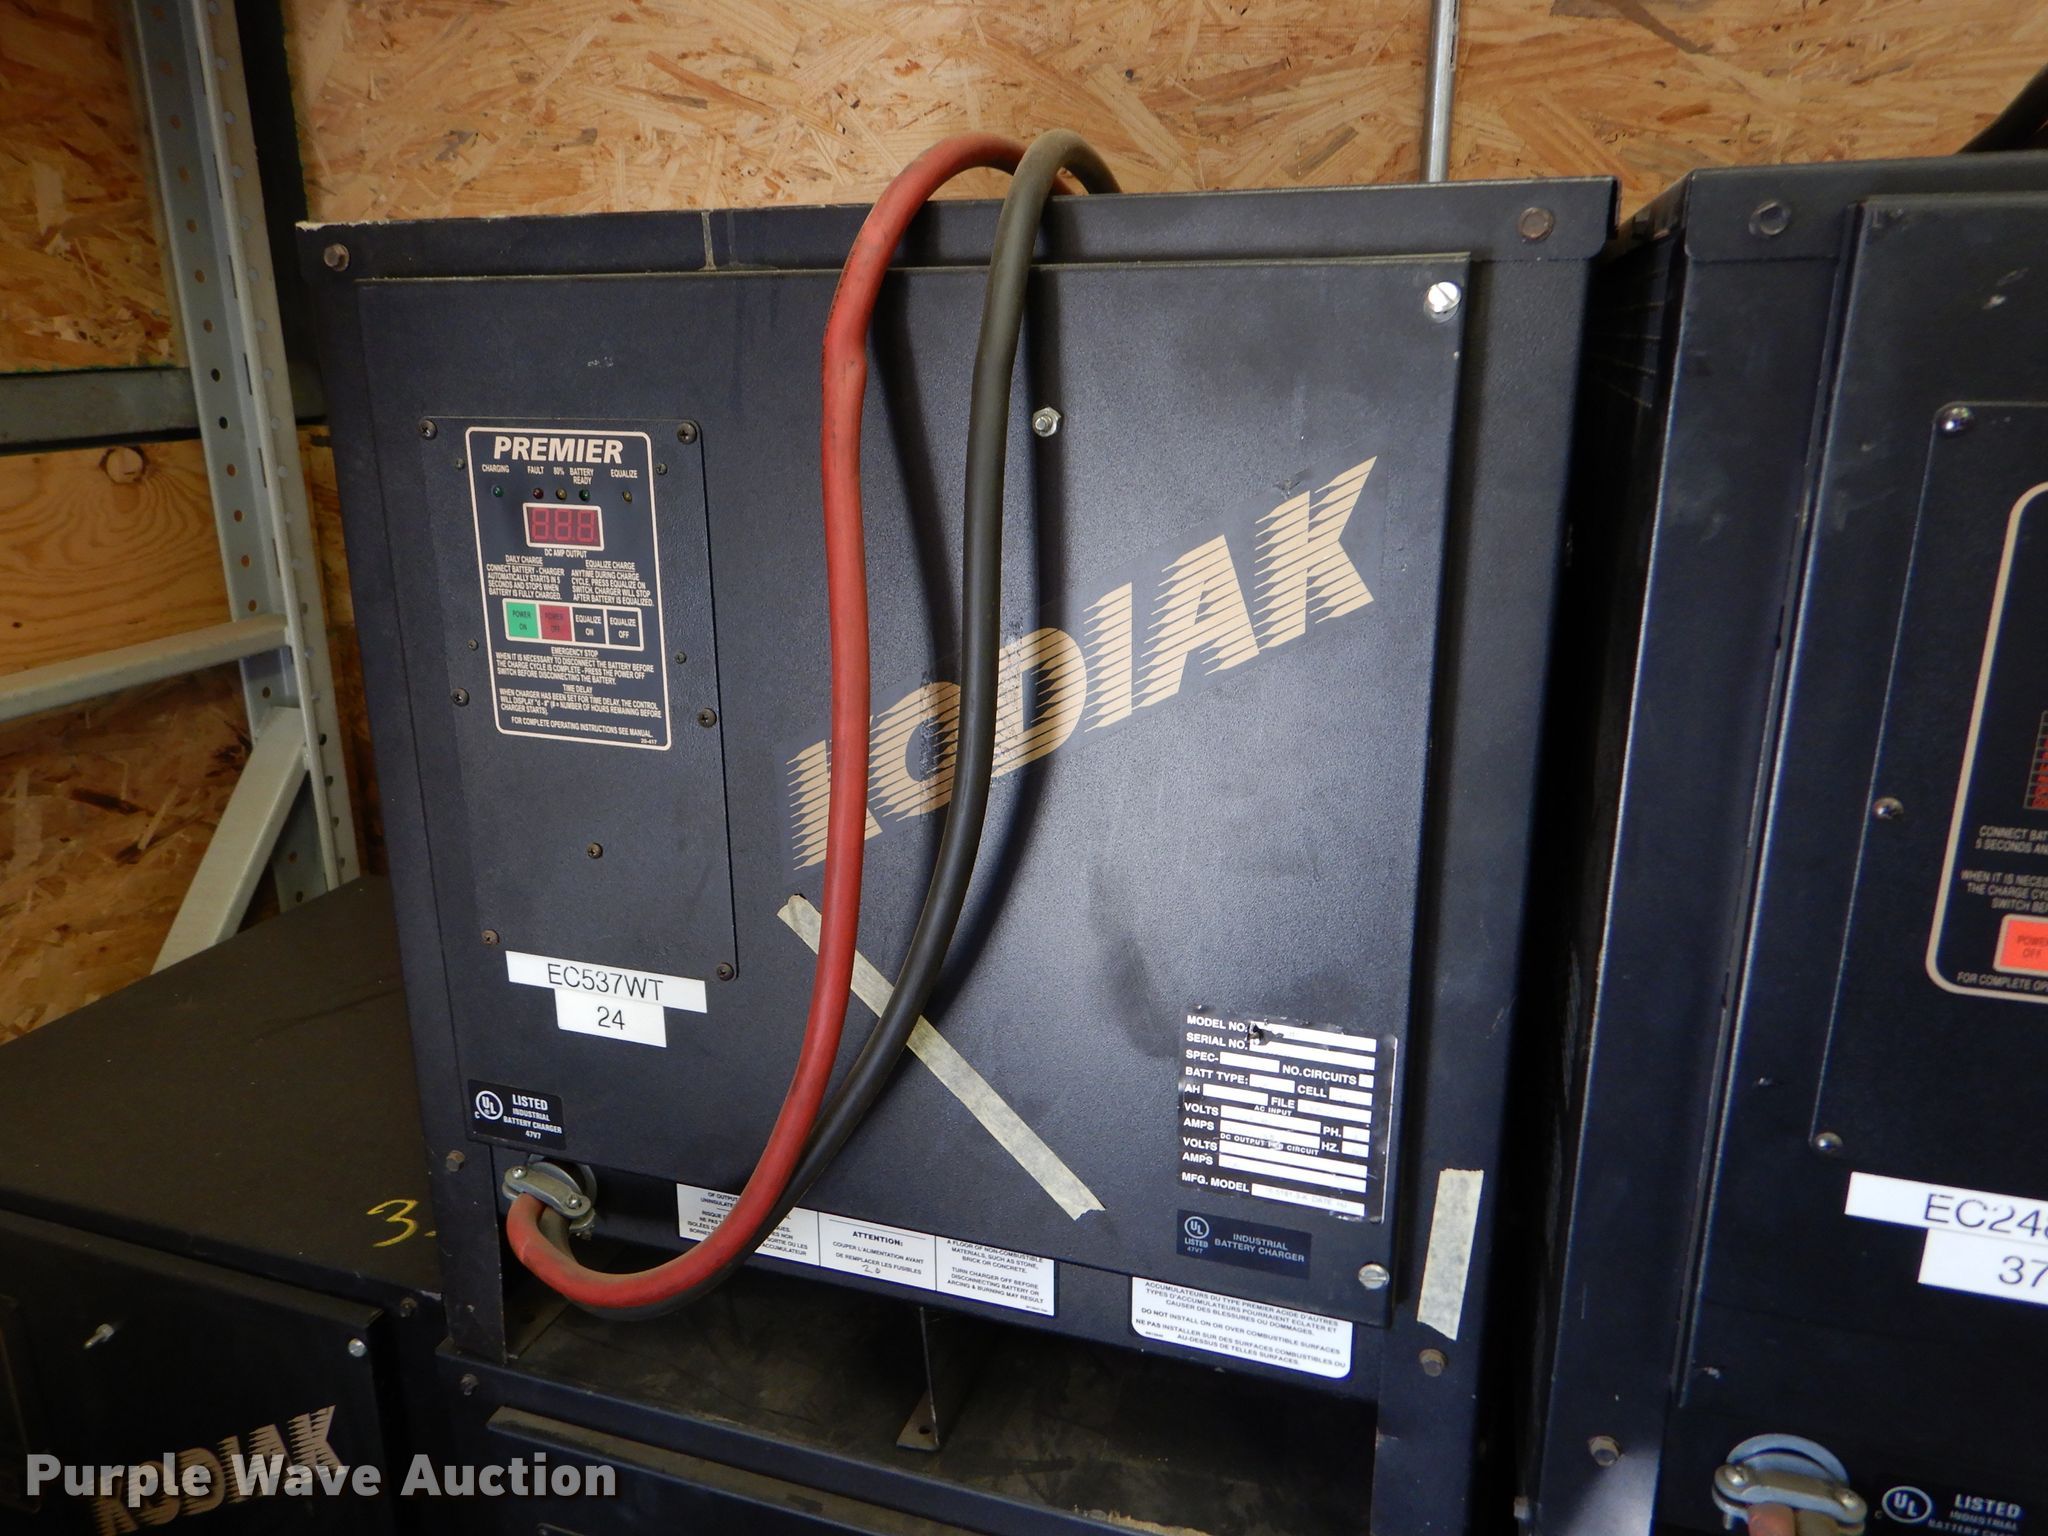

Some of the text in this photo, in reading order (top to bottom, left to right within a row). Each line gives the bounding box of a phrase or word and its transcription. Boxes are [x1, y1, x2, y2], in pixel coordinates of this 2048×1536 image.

[494, 436, 623, 464] PREMIER
[482, 465, 509, 473] CHARGING
[528, 466, 544, 474] FAULT
[570, 468, 594, 476] BATTERY
[611, 470, 637, 478] EQUALIZE
[573, 476, 592, 484] READY
[586, 560, 635, 570] EQUALIZE CHARGE
[576, 615, 601, 624] EQUALIZE
[610, 617, 636, 627] EQUALIZE
[585, 628, 594, 636] ON
[1980, 825, 2028, 839] CONNECT
[548, 964, 663, 1000] EC537WT
[1957, 971, 2031, 989] FOR COMPLETE
[598, 1006, 625, 1030] 24
[1187, 1015, 1226, 1030] MODEL
[1186, 1033, 1226, 1046] SERIAL
[1186, 1050, 1218, 1062] SPEC-
[1303, 1068, 1357, 1085] CIRCUITS
[1186, 1067, 1327, 1098] BATT TYPE: CELL
[512, 1094, 547, 1110] LISTED
[1184, 1084, 1295, 1109] AH FILE
[513, 1108, 550, 1121] INDUSTRIAL
[1268, 1107, 1292, 1116] INPUT
[503, 1116, 562, 1133] BATTERY CHARGER
[1185, 1103, 1341, 1137] VOLTS PH.
[1184, 1118, 1339, 1152] AMPS HZ.
[1183, 1137, 1217, 1151] VOLTS
[1234, 1135, 1265, 1146] OUTPUT
[1287, 1145, 1319, 1155] CIRCUIT
[1183, 1152, 1213, 1165] AMPS
[1182, 1172, 1249, 1192] MFG. MODEL
[833, 1241, 856, 1250] COUPER
[853, 1231, 903, 1246] ATTENTION:
[1185, 1238, 1208, 1248] LISTED
[1234, 1233, 1288, 1250] INDUSTRIAL
[988, 1254, 1005, 1262] SUCH
[1215, 1239, 1304, 1262] BATTERY CHARGER
[845, 1255, 880, 1265] REMPLACER
[894, 1264, 921, 1274] FUSIBLES
[969, 1271, 999, 1280] CHARGER
[1014, 1280, 1038, 1289] BEFORE
[1002, 1284, 1028, 1293] BATTERY
[1162, 1324, 1200, 1336] INSTALLER
[1170, 1313, 1199, 1324] INSTALL
[1225, 1324, 1244, 1333] OVER
[1301, 1341, 1340, 1354] SURFACES
[1955, 1493, 2020, 1518] LISTED
